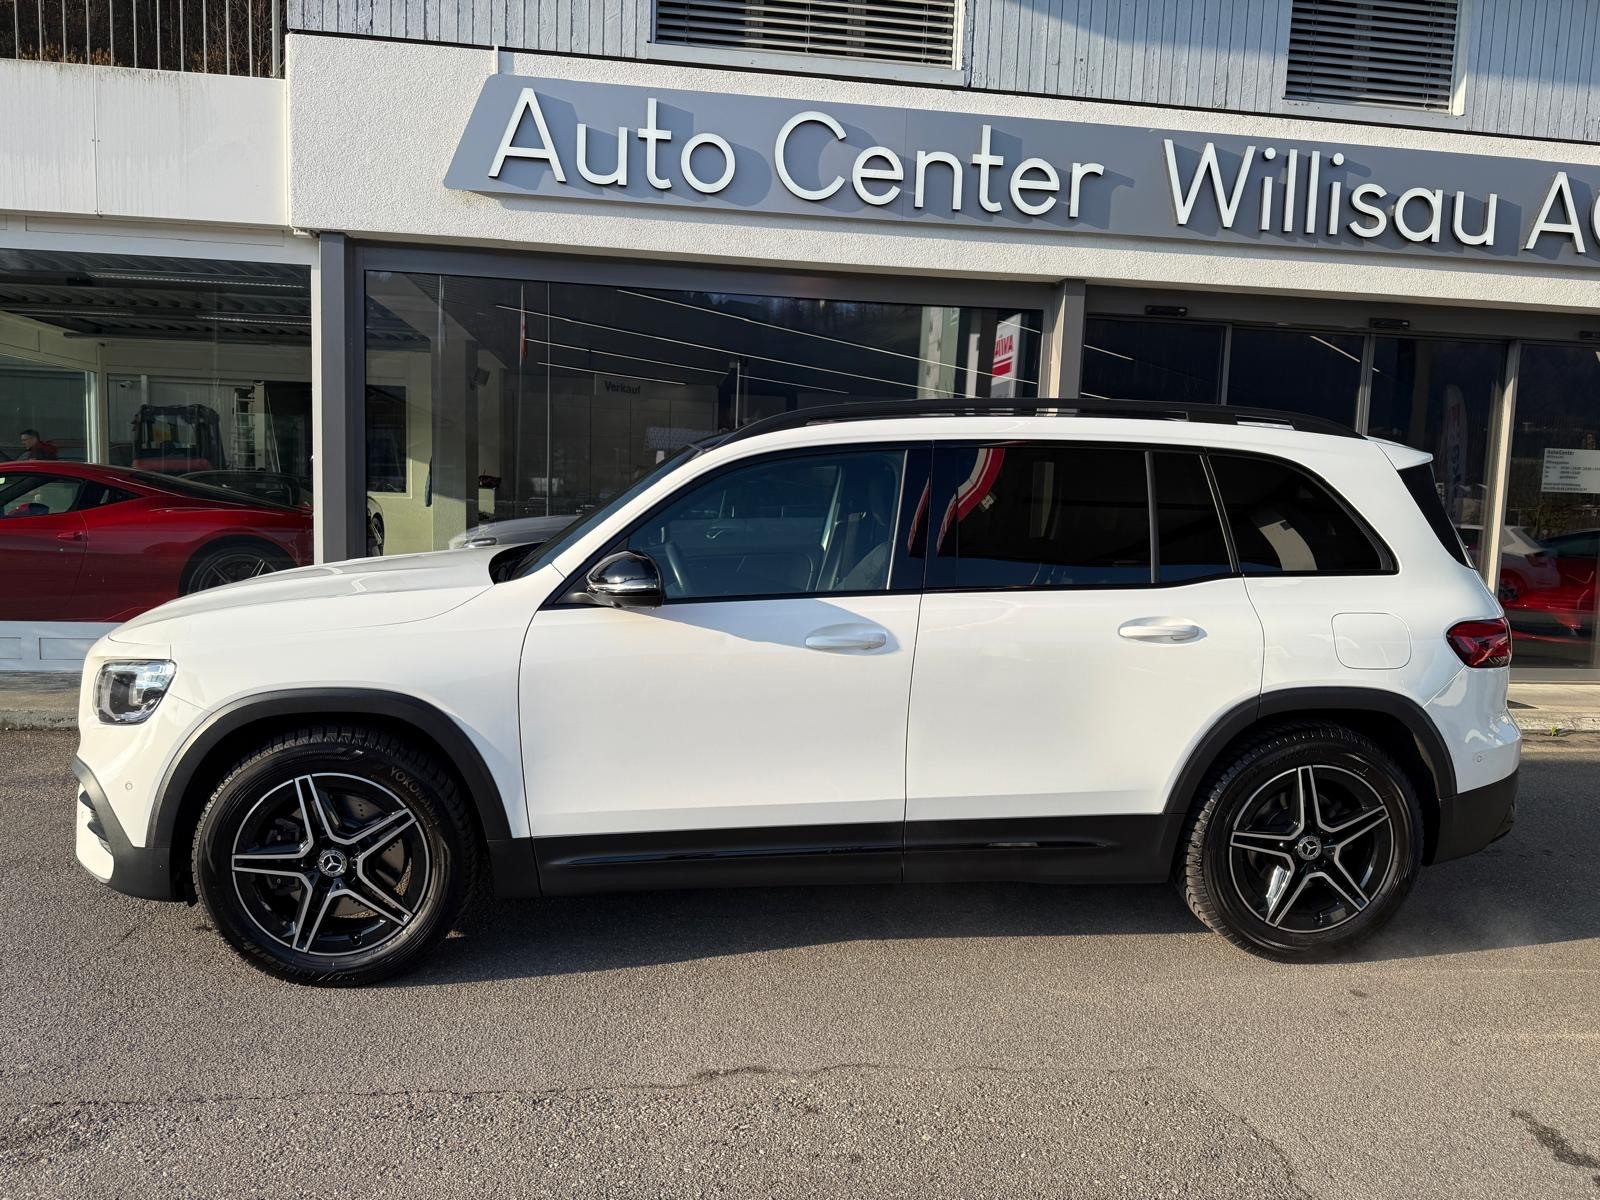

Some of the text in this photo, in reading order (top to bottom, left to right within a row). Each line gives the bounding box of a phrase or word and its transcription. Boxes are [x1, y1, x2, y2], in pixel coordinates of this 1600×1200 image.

[488, 87, 1600, 253] Auto Center Willisau A
[604, 380, 641, 394] Verkauf
[391, 765, 441, 825] YOKOHAMA
